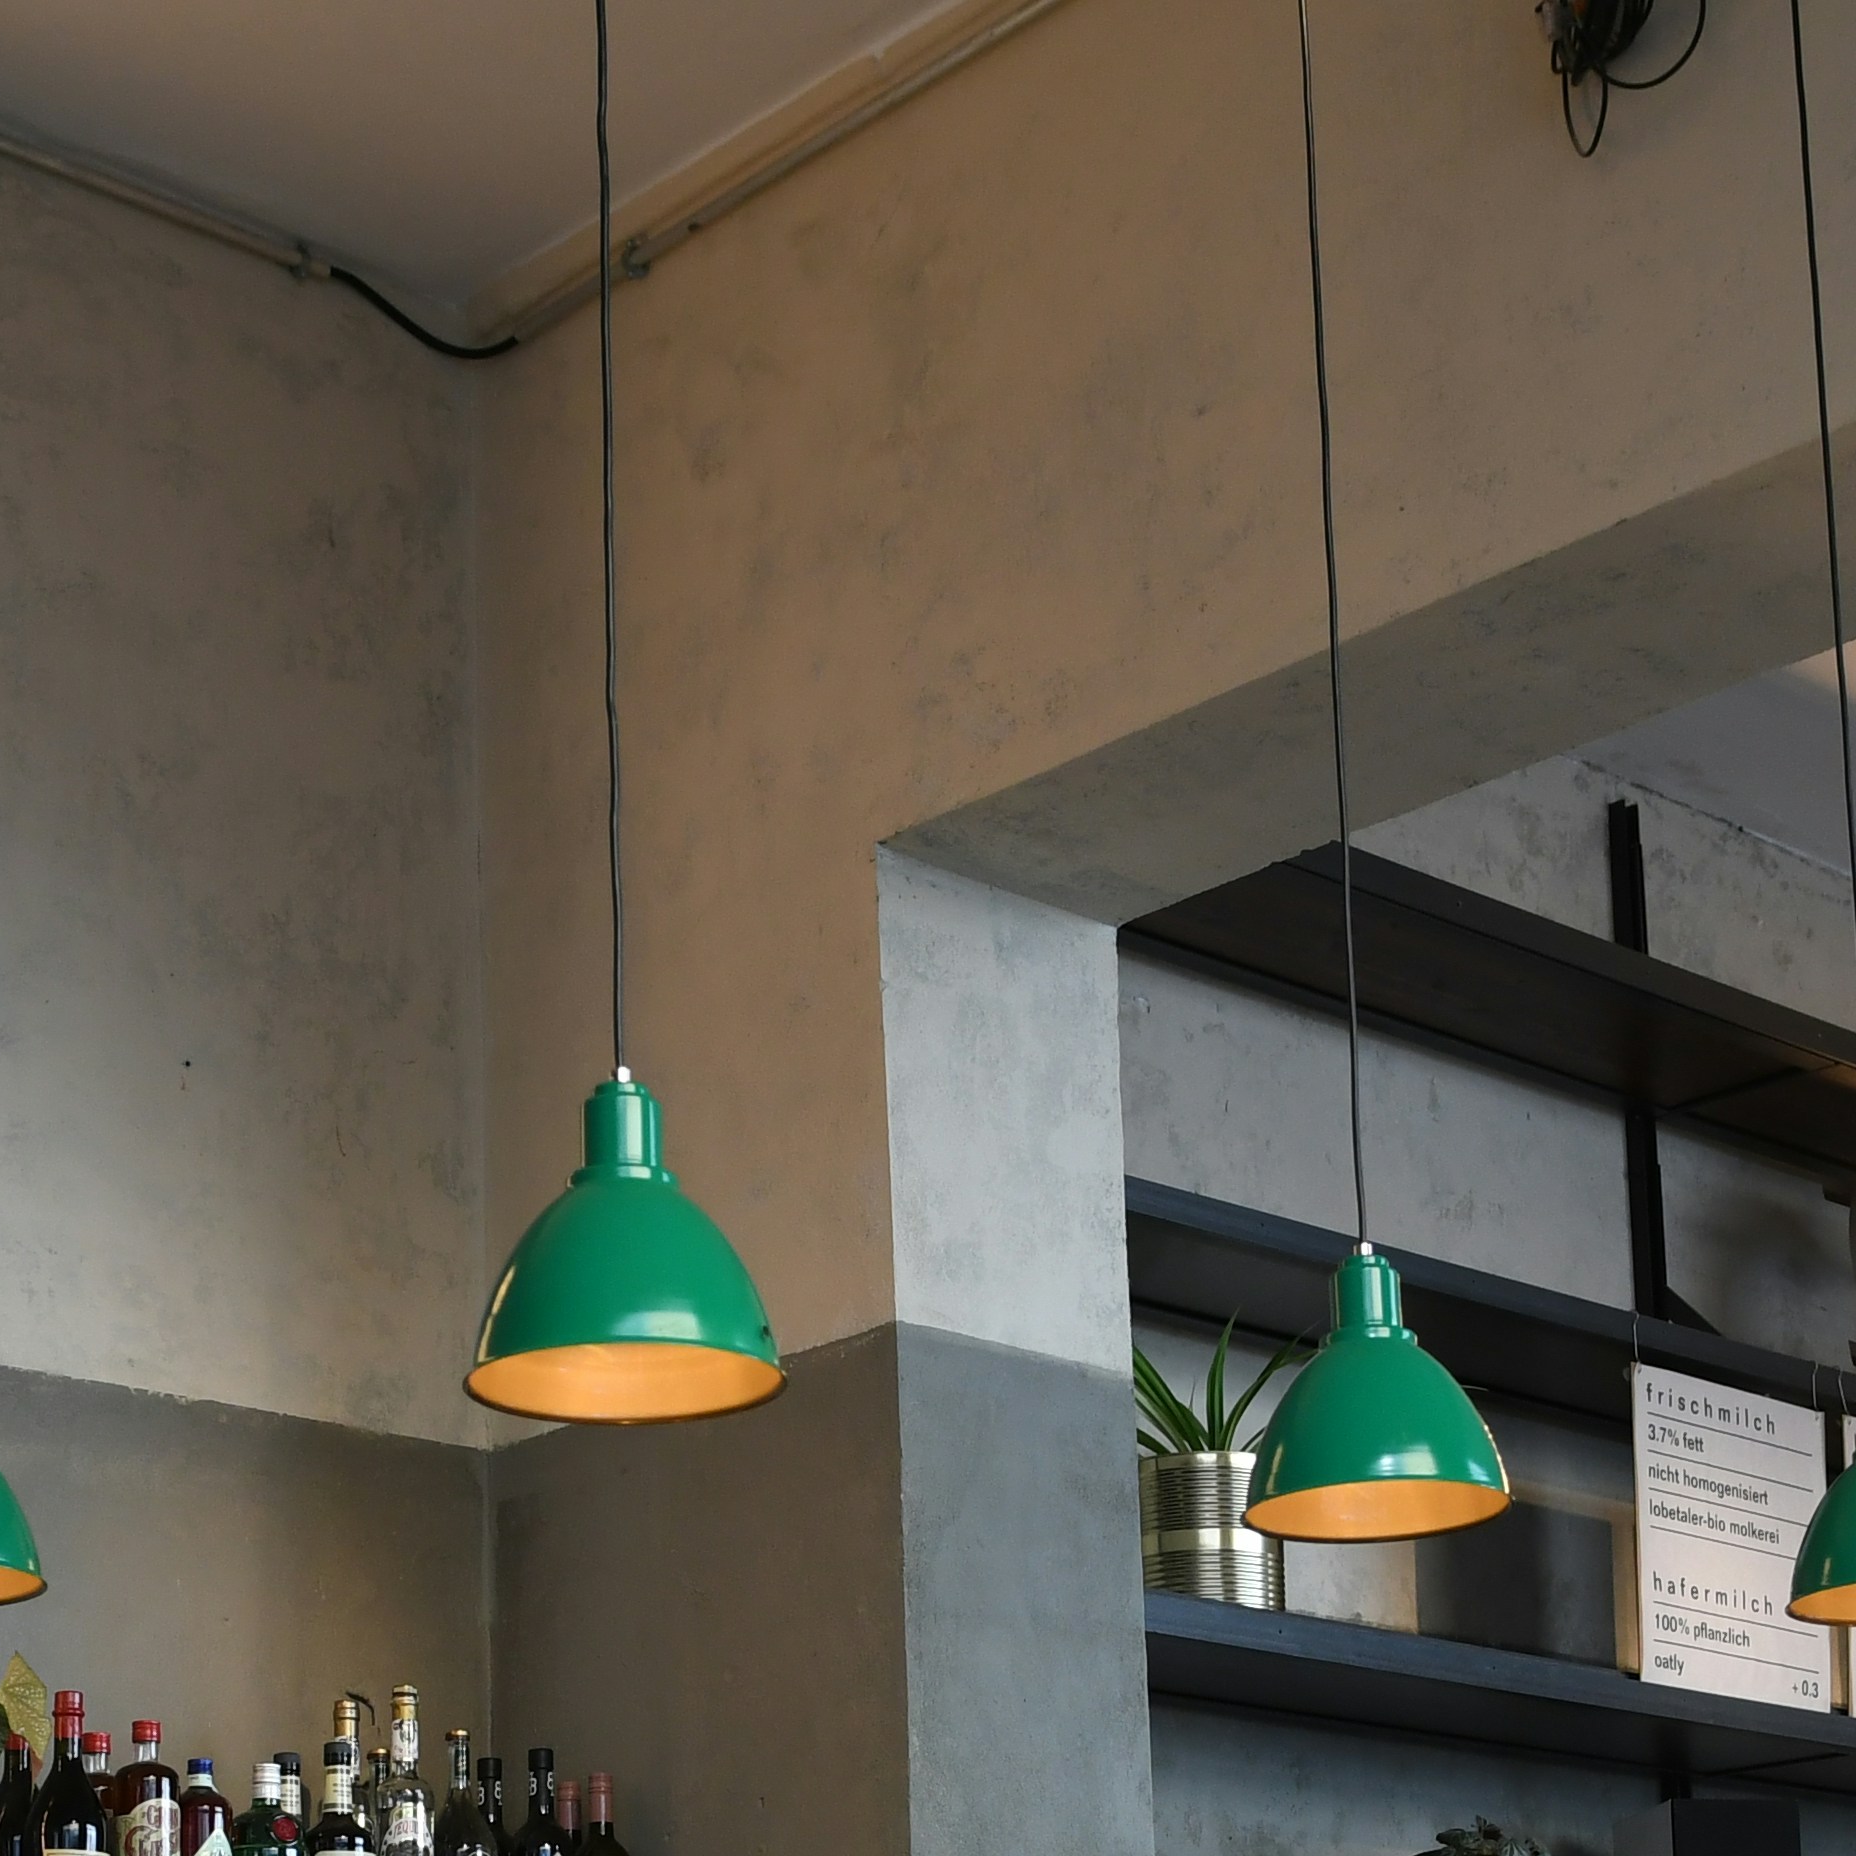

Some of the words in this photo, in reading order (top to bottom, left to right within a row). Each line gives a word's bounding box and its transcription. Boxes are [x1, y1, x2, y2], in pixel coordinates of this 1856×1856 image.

[1645, 1382, 1776, 1435] frischmilch
[1647, 1423, 1680, 1447] 3.7%
[1682, 1432, 1705, 1453] fett
[1648, 1463, 1680, 1485] nicht
[1683, 1469, 1769, 1506] homogenisiert
[1649, 1498, 1726, 1532] lobetaler-bio
[1729, 1521, 1780, 1545] molkerei
[1652, 1570, 1773, 1616] hafermilch
[1654, 1612, 1690, 1636] 100%
[1693, 1621, 1751, 1648] pflanzlich
[1654, 1653, 1685, 1677] oatly
[1801, 1679, 1820, 1699] 0.3
